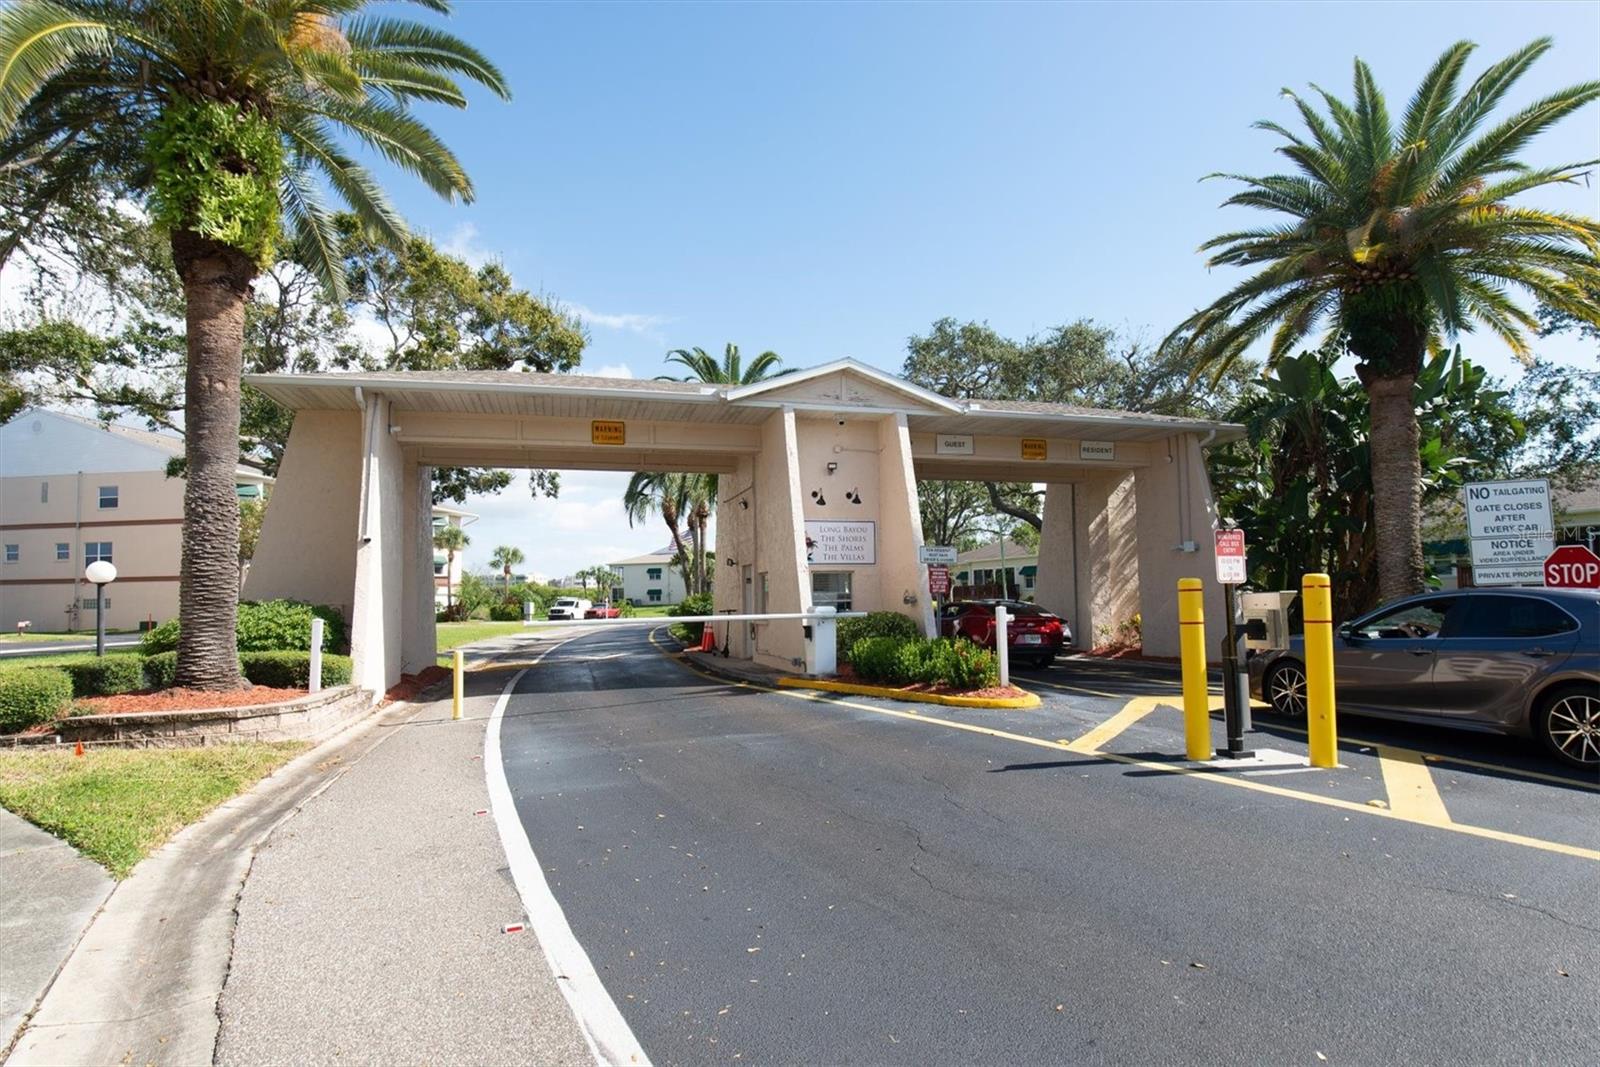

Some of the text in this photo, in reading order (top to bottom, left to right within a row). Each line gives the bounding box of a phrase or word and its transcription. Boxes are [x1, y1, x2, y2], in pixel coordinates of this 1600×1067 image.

[944, 440, 965, 448] GUEST
[1081, 446, 1112, 454] RESIDENT
[1469, 486, 1545, 500] NO TAILGATING
[1475, 502, 1543, 513] GATE CLOSES
[1494, 513, 1526, 522] AFTER
[1483, 524, 1538, 534] EVERY CAR
[1491, 540, 1534, 549] NOTICE
[1548, 563, 1598, 584] STOP
